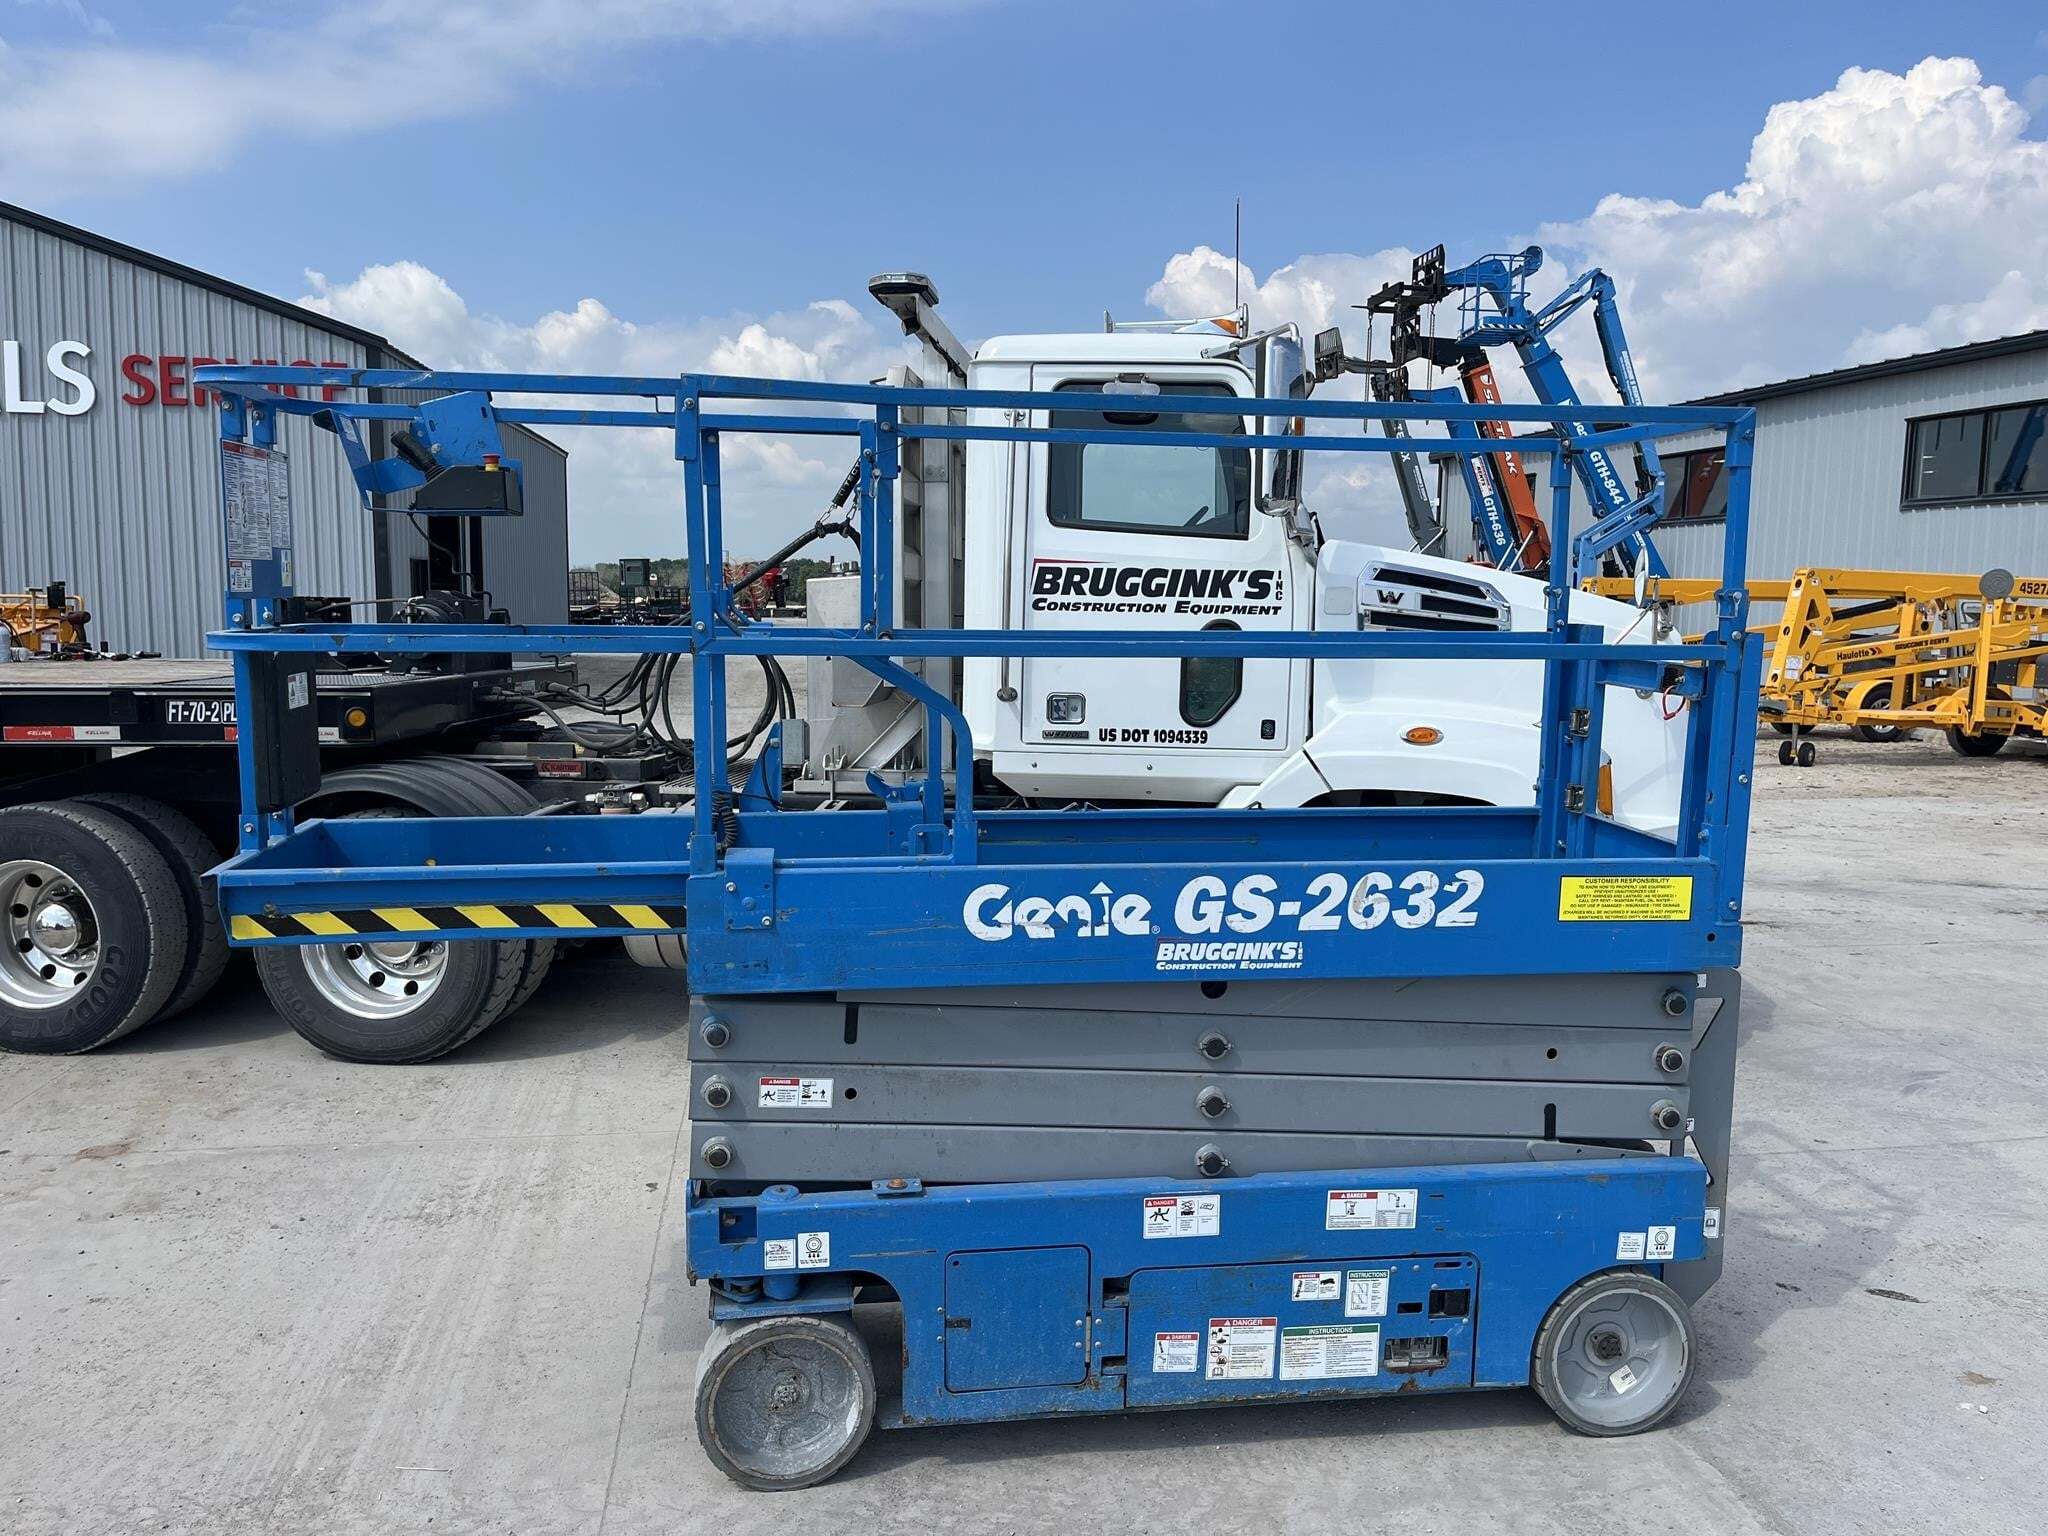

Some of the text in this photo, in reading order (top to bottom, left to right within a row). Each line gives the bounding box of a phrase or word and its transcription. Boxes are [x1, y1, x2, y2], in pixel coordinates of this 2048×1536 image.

[0, 340, 97, 416] LS
[1590, 451, 1624, 505] GTH-844
[1484, 497, 1506, 546] GTH-636
[1032, 566, 1276, 600] BRUGGINK'S
[2019, 582, 2048, 596] 4527
[1032, 598, 1282, 616] CONSTRUCTION EQUIPMENT
[1837, 649, 1870, 661] Haulotte
[167, 701, 219, 722] FT-70-2
[1098, 728, 1208, 744] US DOT 1094339
[962, 869, 1485, 942] Genie GS-2632
[1156, 941, 1299, 961] BRUGGINK'S
[1156, 961, 1303, 971] CONSTRUCTION EQUIPMENT
[1349, 1271, 1387, 1279] INSTRUCTIONS
[1309, 1326, 1353, 1335] INSTRUCTIONS
